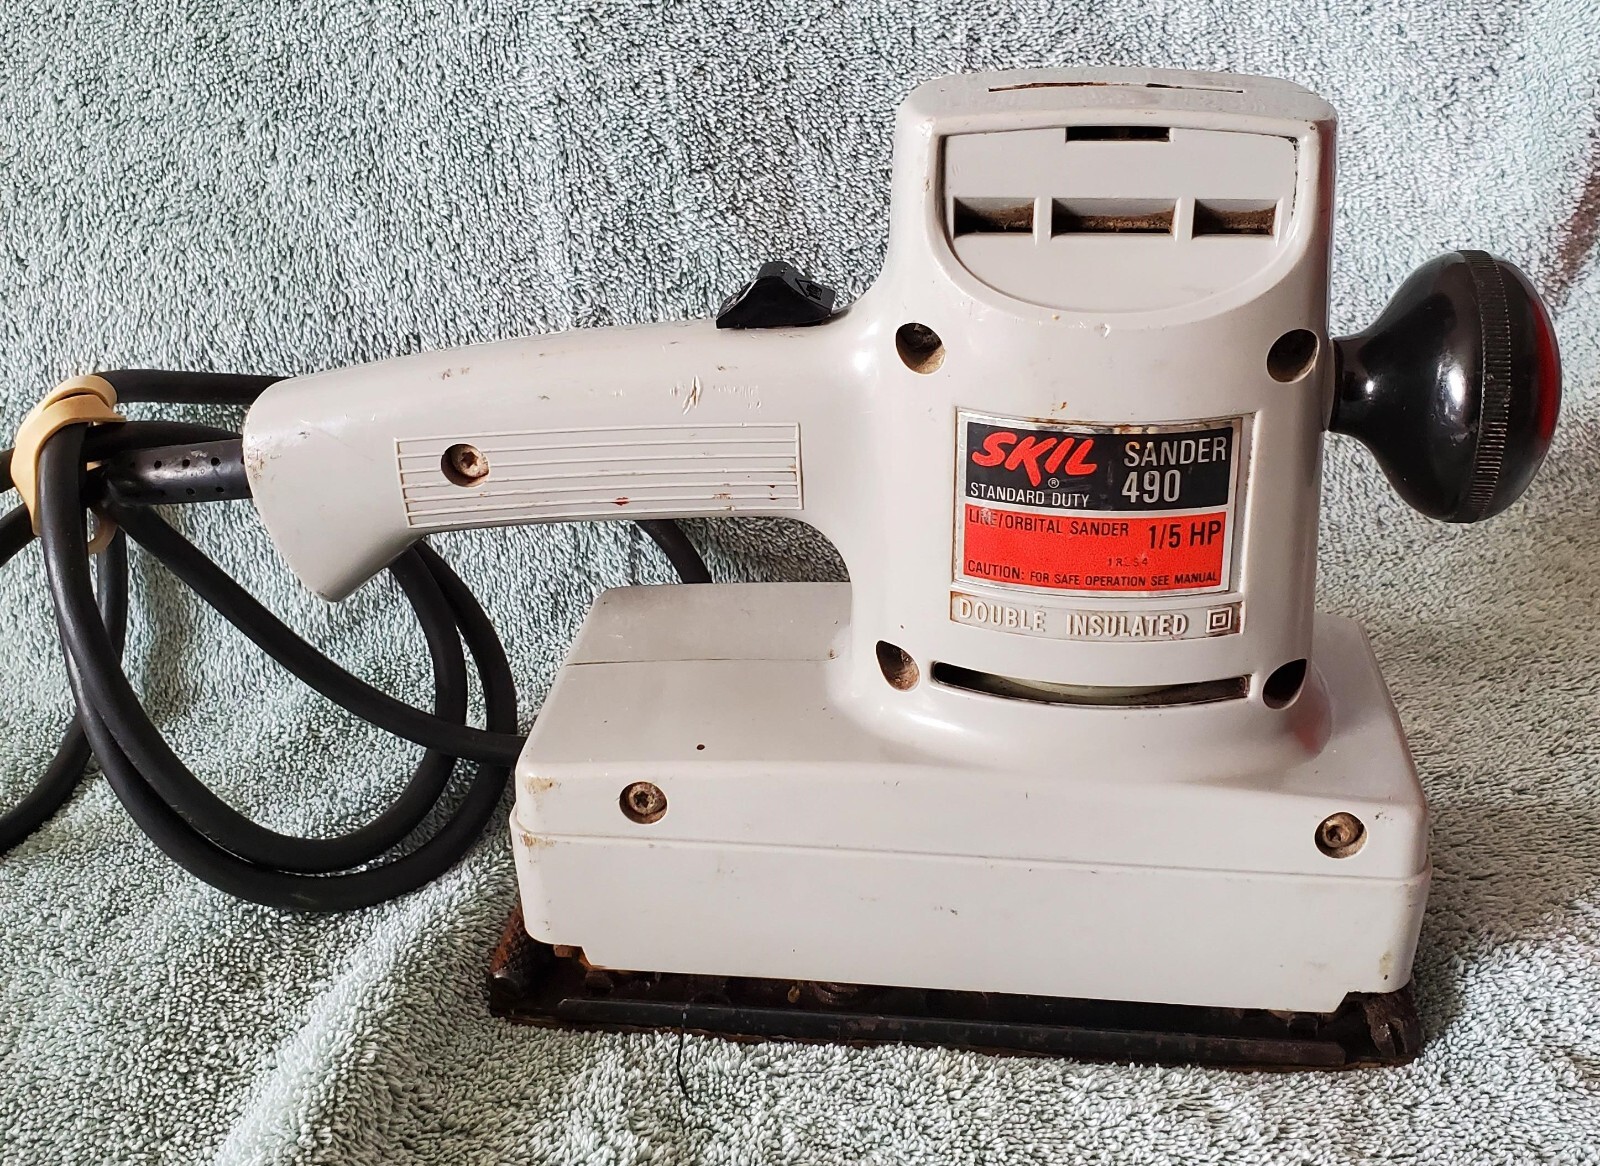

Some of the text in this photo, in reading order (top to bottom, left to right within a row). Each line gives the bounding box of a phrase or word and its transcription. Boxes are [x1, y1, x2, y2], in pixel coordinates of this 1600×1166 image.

[971, 432, 1098, 487] SKIL
[1124, 436, 1227, 467] SANDER
[970, 482, 1090, 508] STANDARD DUTY
[1121, 469, 1181, 504] 490
[1070, 520, 1130, 536] SANDER
[1148, 520, 1222, 550] 1/5 HP
[967, 559, 1218, 587] CAUTION: FOR SAFE OPERATION SEE MANUAL
[958, 597, 1188, 637] DOUBLE INSULATED
